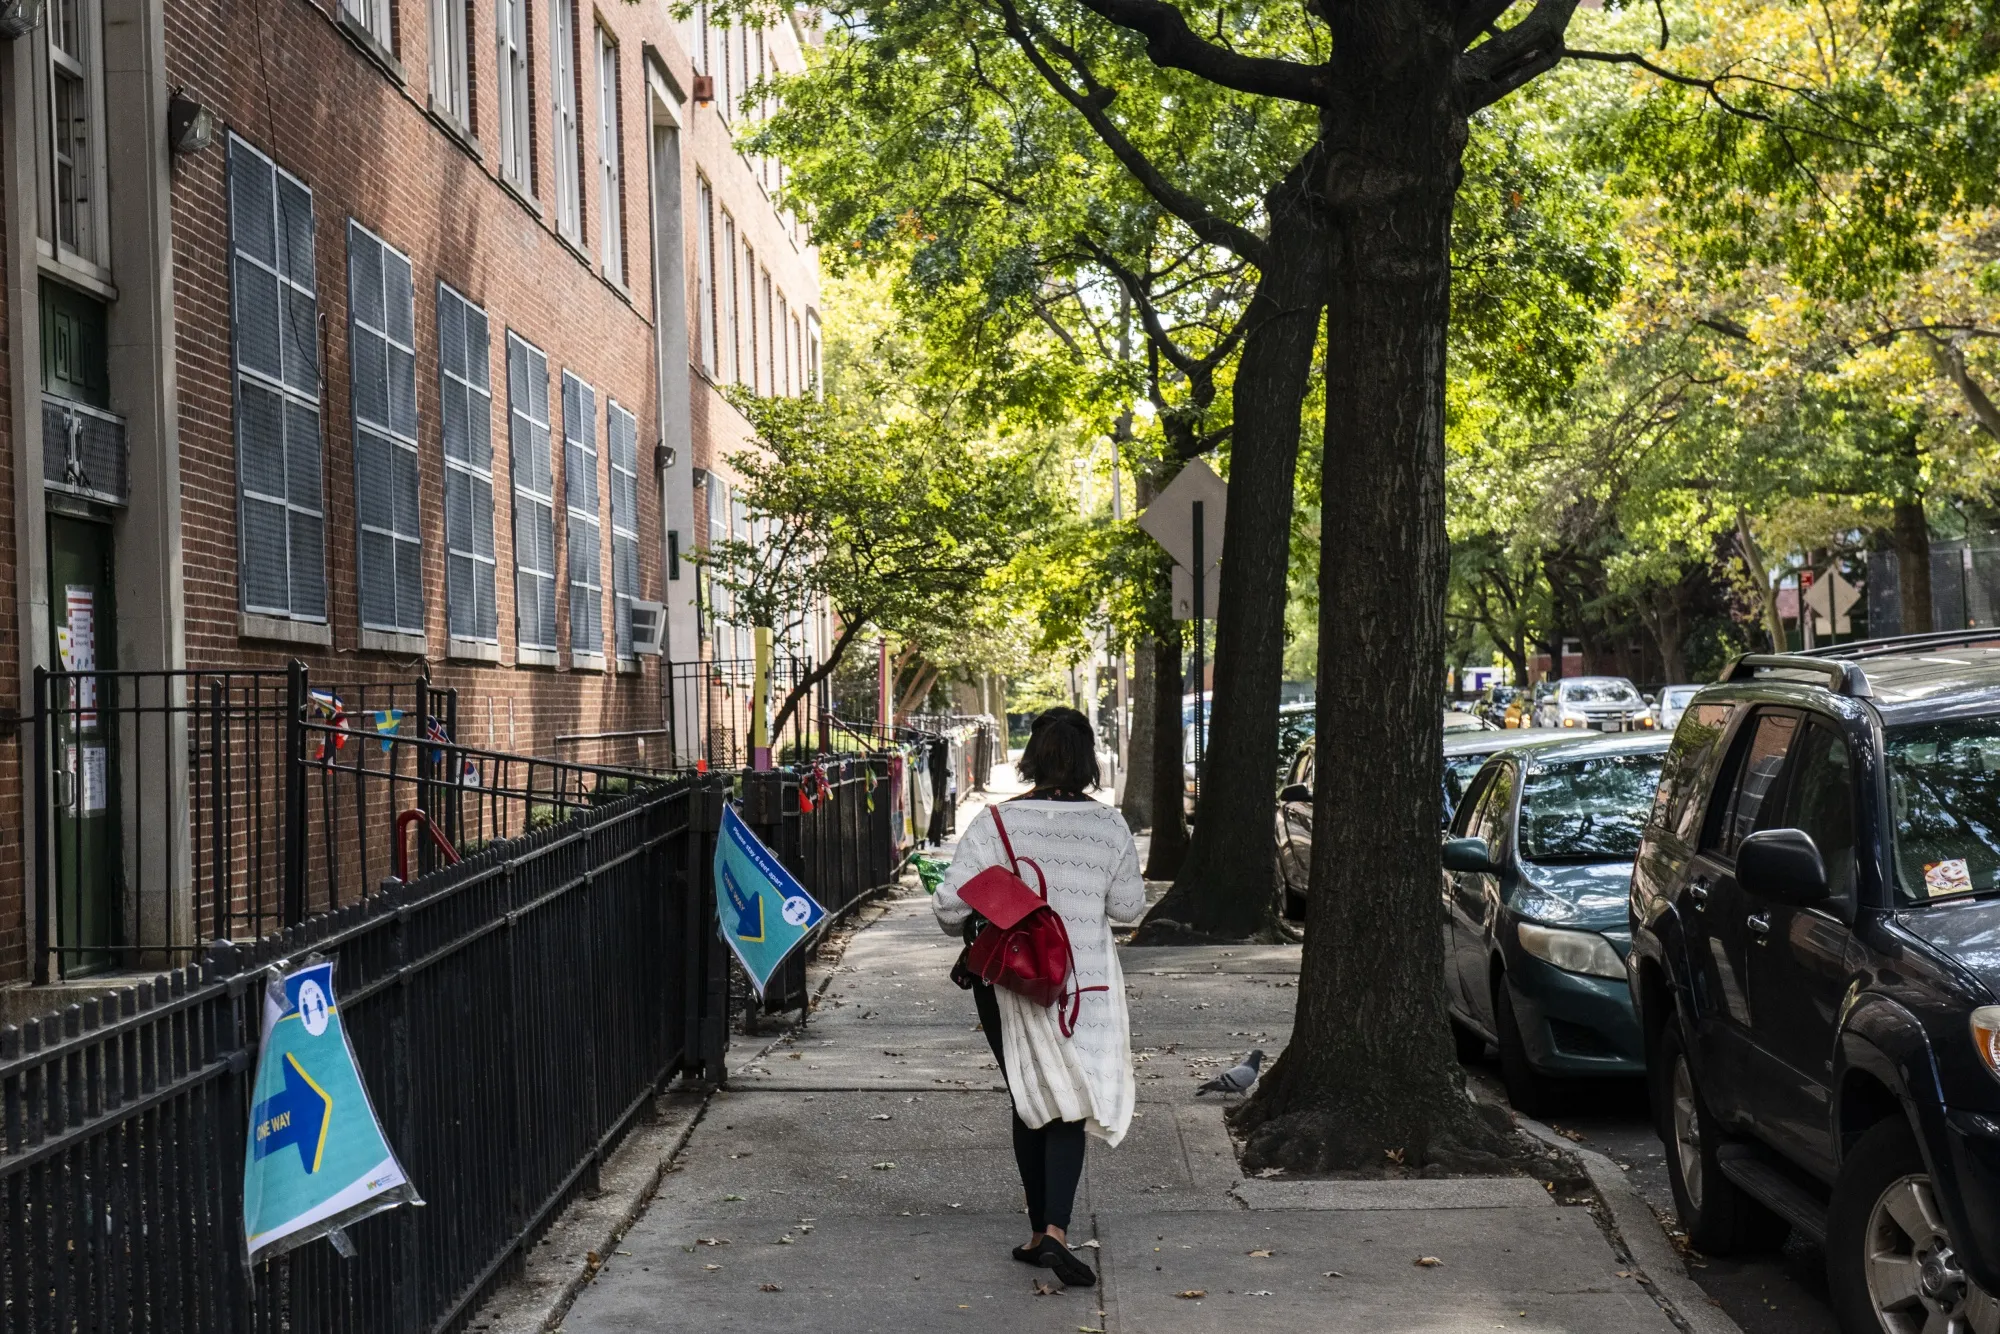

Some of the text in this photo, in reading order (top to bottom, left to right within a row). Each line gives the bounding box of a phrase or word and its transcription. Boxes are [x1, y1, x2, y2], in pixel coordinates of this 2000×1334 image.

[733, 826, 746, 845] Please
[745, 844, 756, 857] stay
[759, 860, 770, 873] feet
[768, 871, 784, 888] apart
[733, 891, 746, 911] WAY
[256, 1110, 291, 1142] ONE WAY
